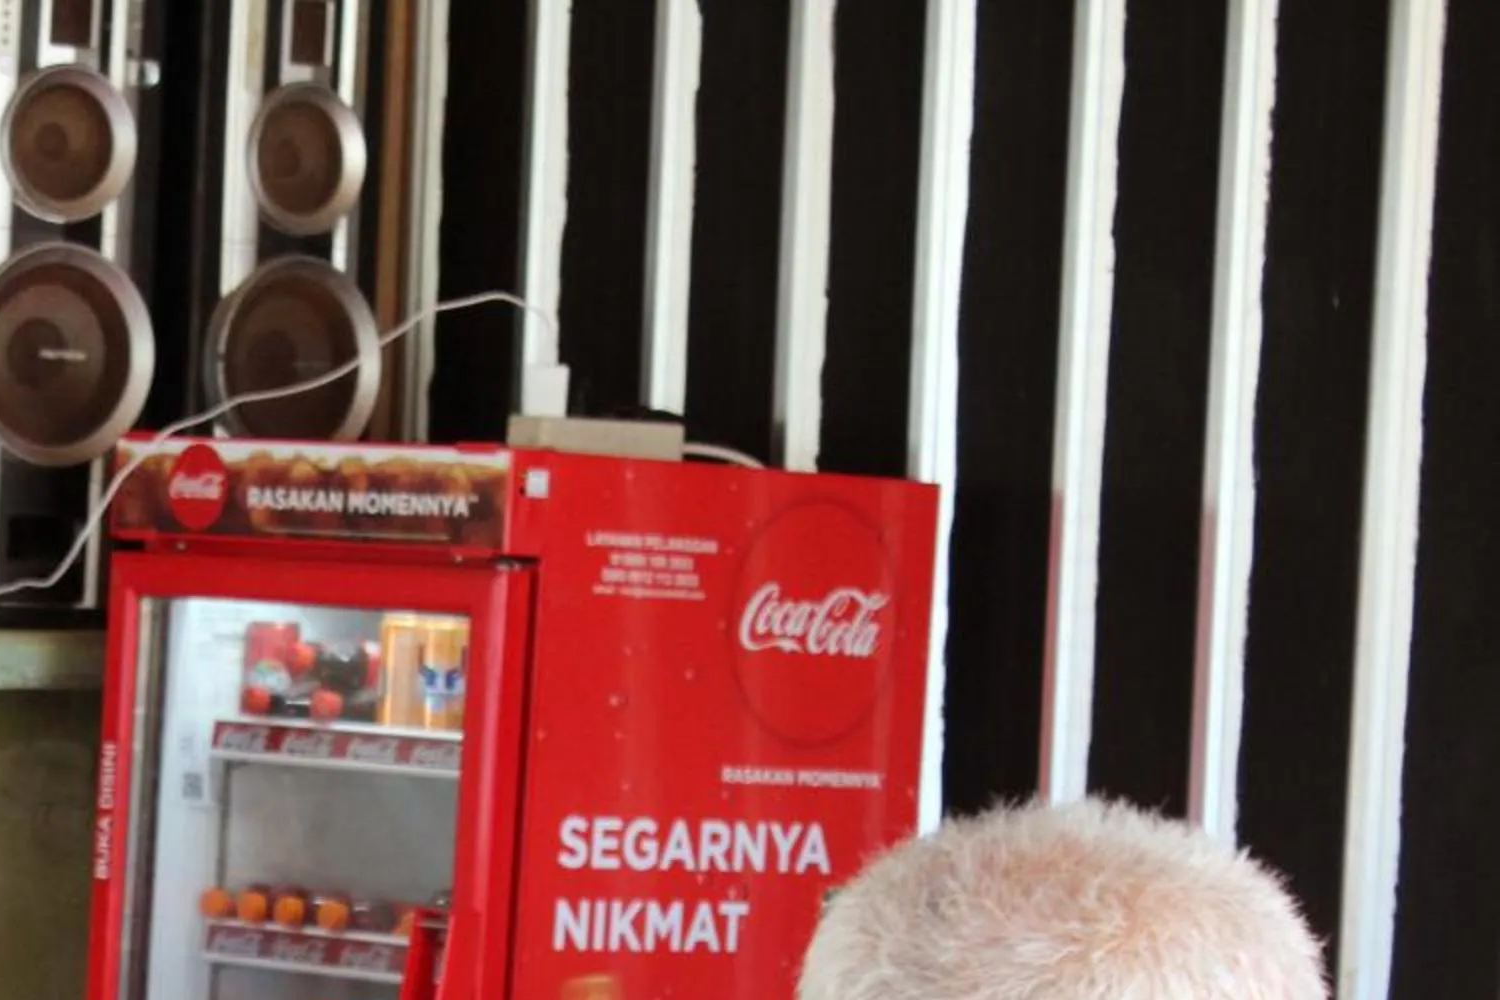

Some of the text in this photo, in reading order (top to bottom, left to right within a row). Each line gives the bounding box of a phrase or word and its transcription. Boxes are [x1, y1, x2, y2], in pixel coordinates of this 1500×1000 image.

[248, 485, 344, 511] RASAKAN
[557, 815, 832, 875] SEGARNYA
[553, 897, 750, 952] NIKMAT
